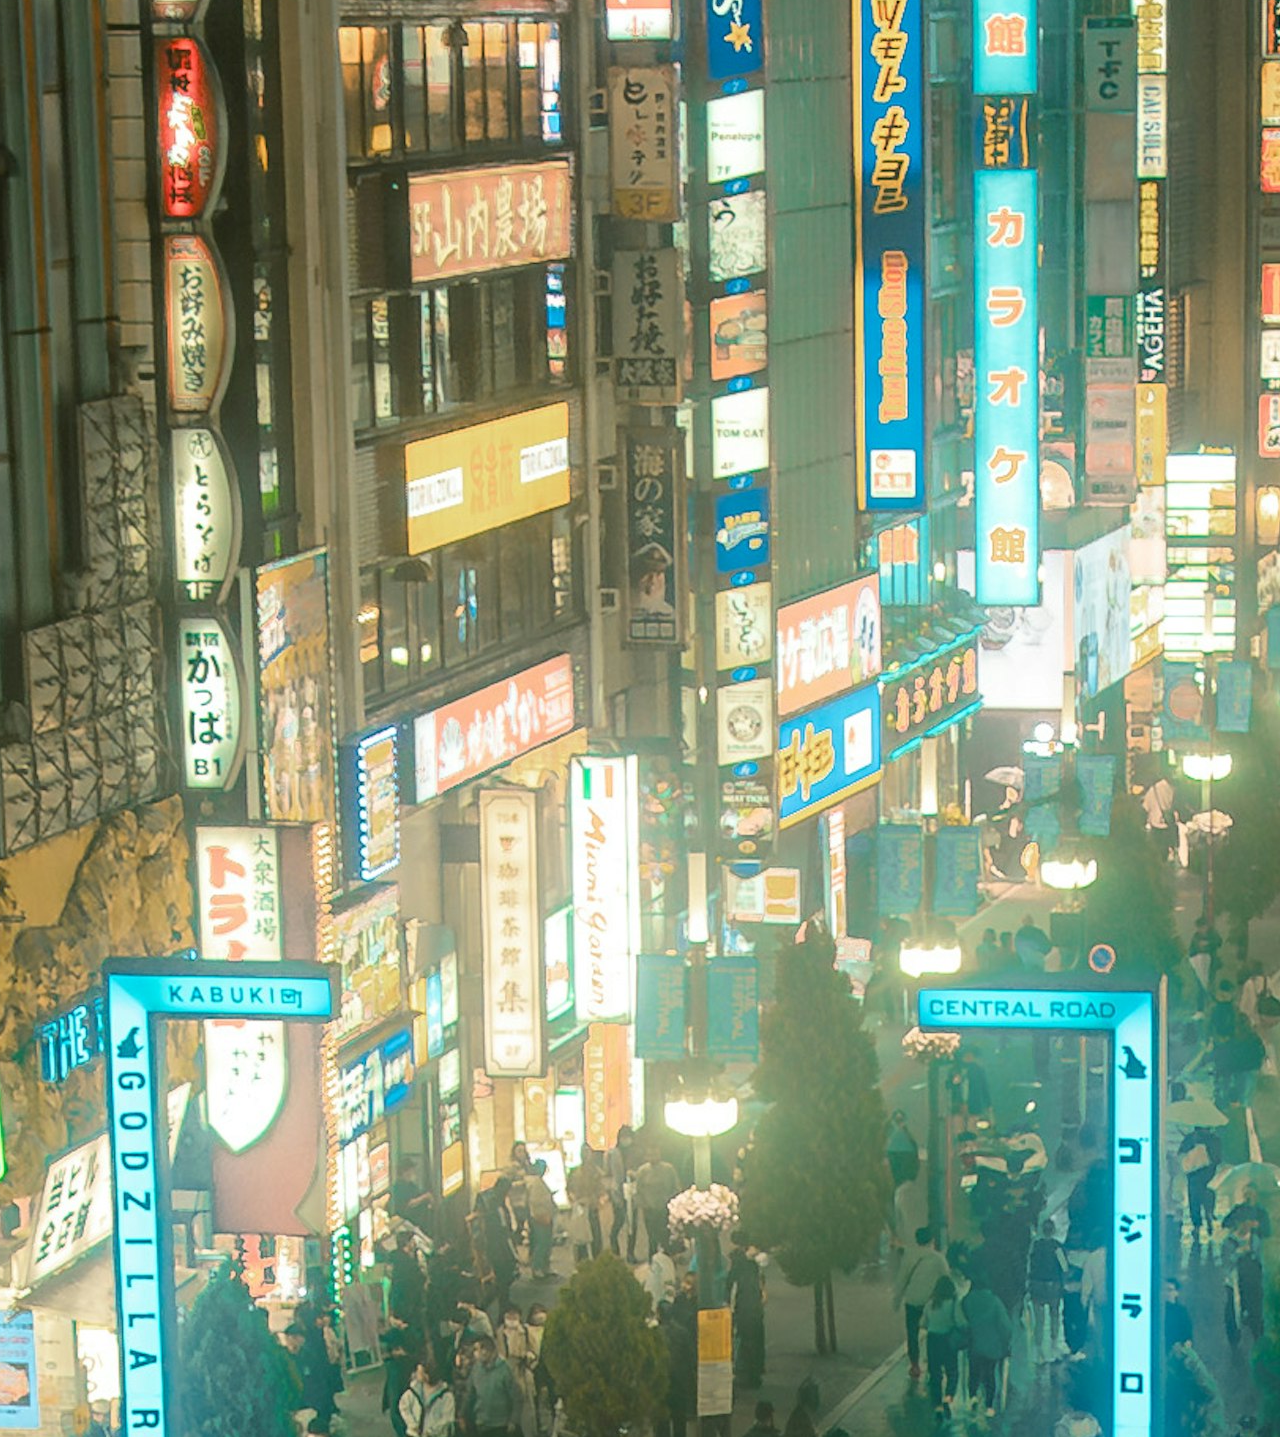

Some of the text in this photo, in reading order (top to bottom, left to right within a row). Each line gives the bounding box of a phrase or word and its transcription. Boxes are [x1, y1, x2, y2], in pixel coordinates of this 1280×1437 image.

[711, 130, 762, 142] Penelope
[433, 175, 548, 269] 山内農場
[179, 264, 207, 394] お好み焼き
[1144, 289, 1164, 371] AGEHA
[985, 206, 1028, 566] カラオケ館
[716, 427, 765, 439] TOM CAT
[186, 581, 214, 602] 1F
[185, 649, 225, 747] かっぱ
[193, 757, 223, 777] B1
[252, 832, 278, 943] 大衆酒場
[928, 998, 1116, 1020] CENTRAL ROAD
[116, 1070, 160, 1374] GODZILLA
